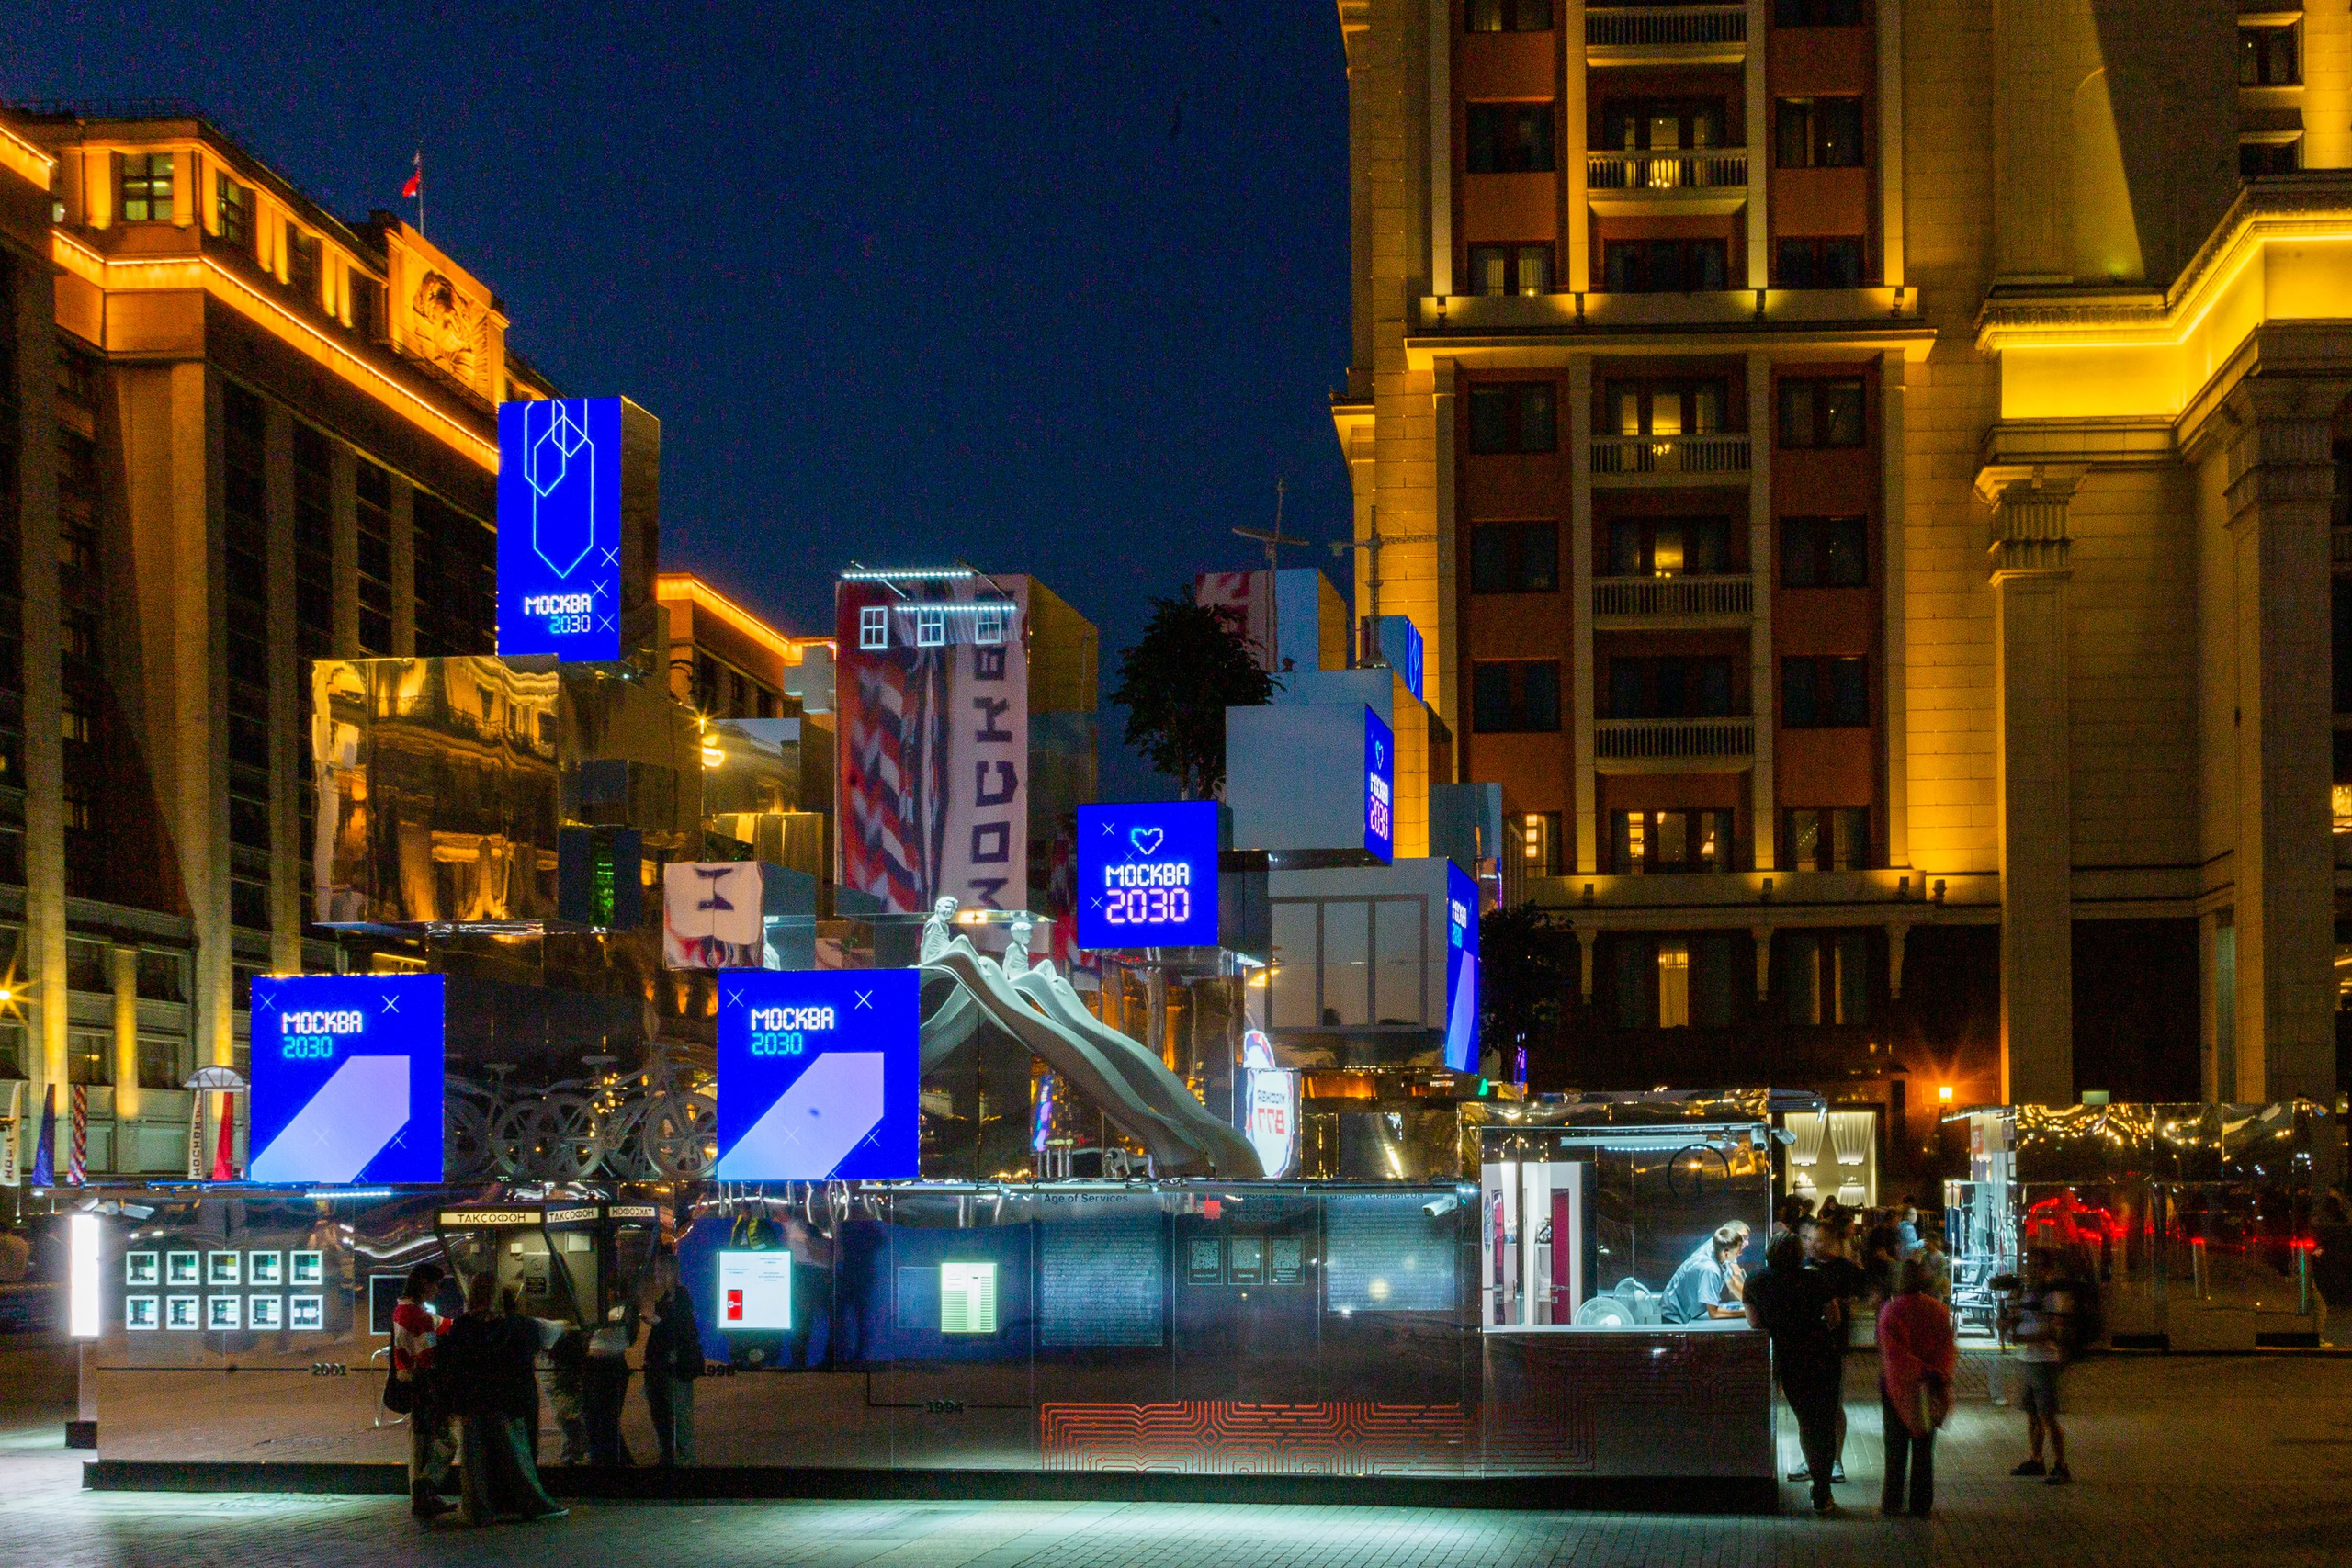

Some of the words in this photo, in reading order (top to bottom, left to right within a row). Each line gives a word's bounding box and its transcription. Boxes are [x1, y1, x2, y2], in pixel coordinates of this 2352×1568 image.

[524, 593, 591, 615] МОСКВА
[549, 615, 591, 634] 2030
[1370, 795, 1388, 840] 2030
[1105, 863, 1190, 887] МОСКВА
[1106, 887, 1189, 924] 2030
[281, 1010, 363, 1034] МОСКВА
[751, 1007, 834, 1031] МОСКВА
[282, 1036, 333, 1059] 2030
[752, 1032, 803, 1055] 2030
[1044, 1194, 1065, 1204] Age
[1068, 1194, 1079, 1202] of
[1081, 1194, 1129, 1203] Services
[457, 1213, 526, 1224] ТАКСОФОН
[548, 1209, 594, 1223] ТАКСОФОН
[311, 1362, 348, 1376] 2001
[926, 1400, 965, 1415] 1994
